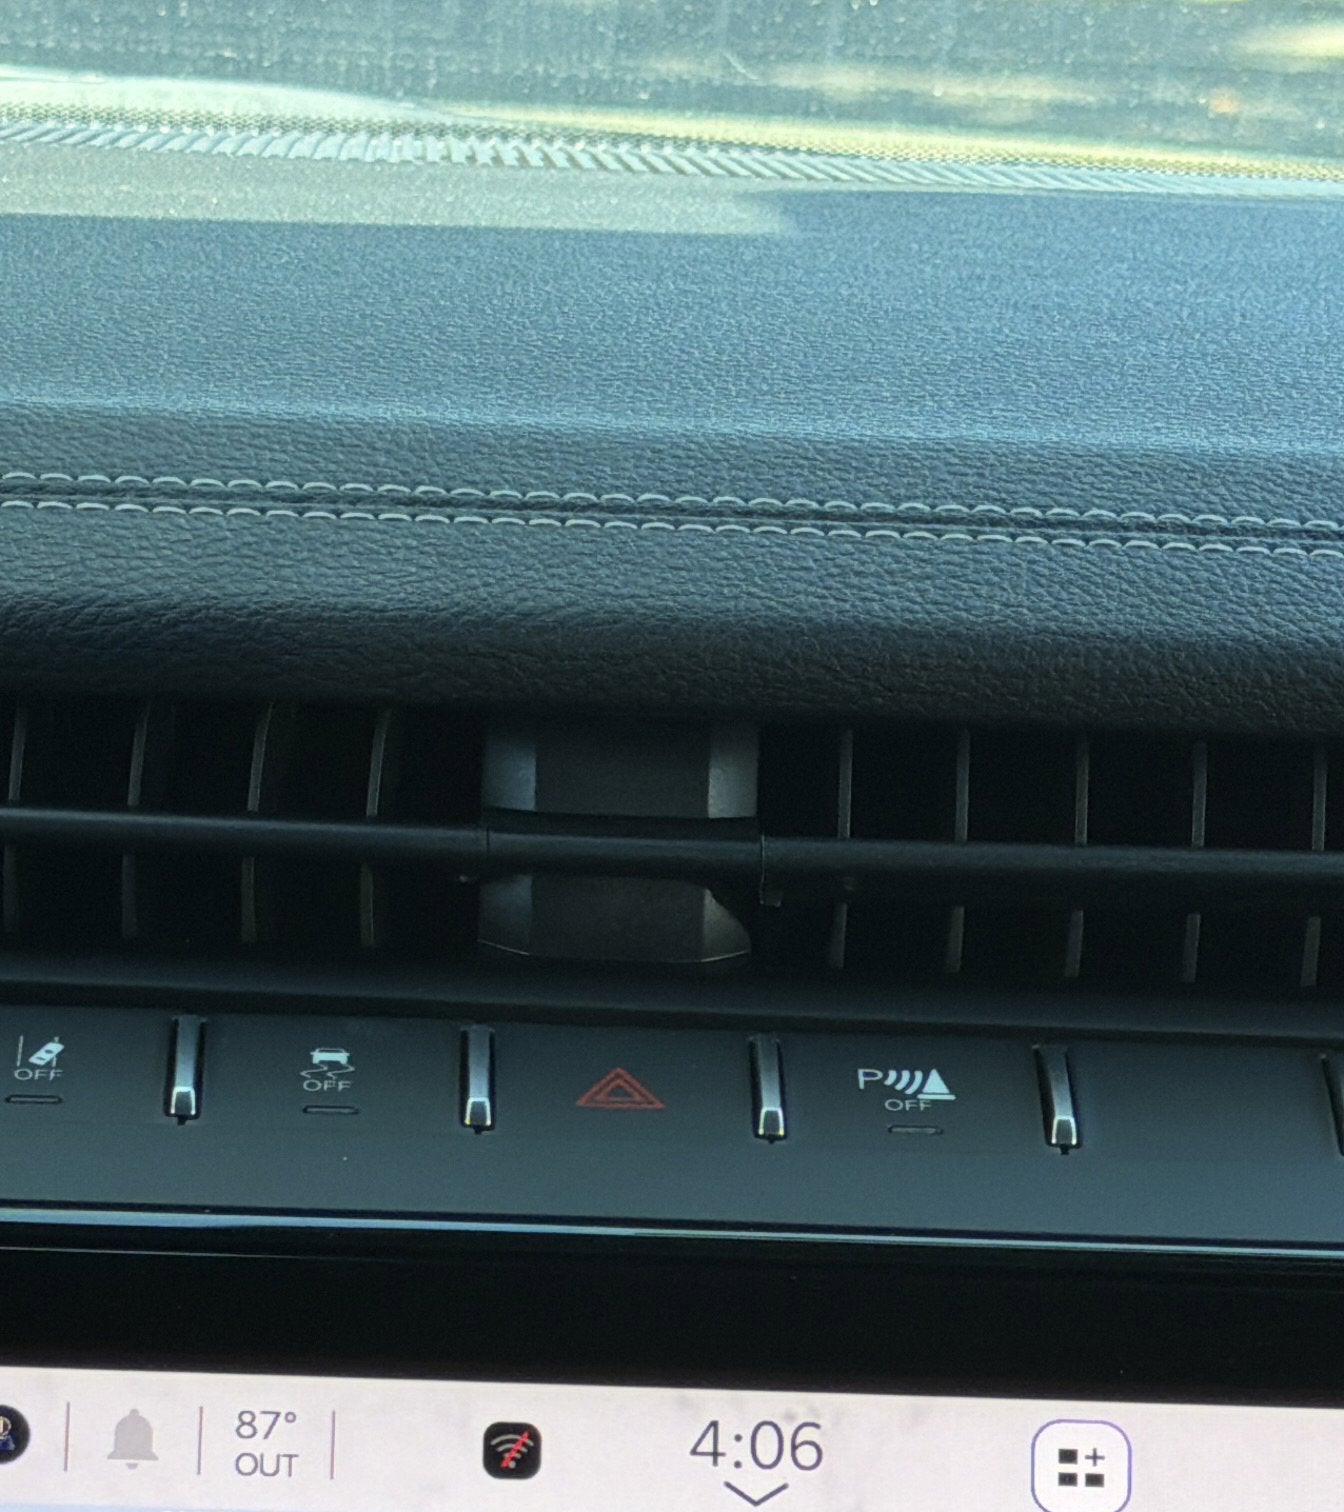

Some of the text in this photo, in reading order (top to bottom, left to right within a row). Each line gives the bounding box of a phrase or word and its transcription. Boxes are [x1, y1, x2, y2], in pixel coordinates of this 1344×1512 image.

[14, 1069, 63, 1081] OFF
[302, 1079, 353, 1092] OFF
[857, 1068, 883, 1090] P
[884, 1099, 932, 1111] OFF
[235, 1411, 296, 1440] 87°
[689, 1420, 824, 1472] 4:06
[234, 1452, 299, 1478] OUT
